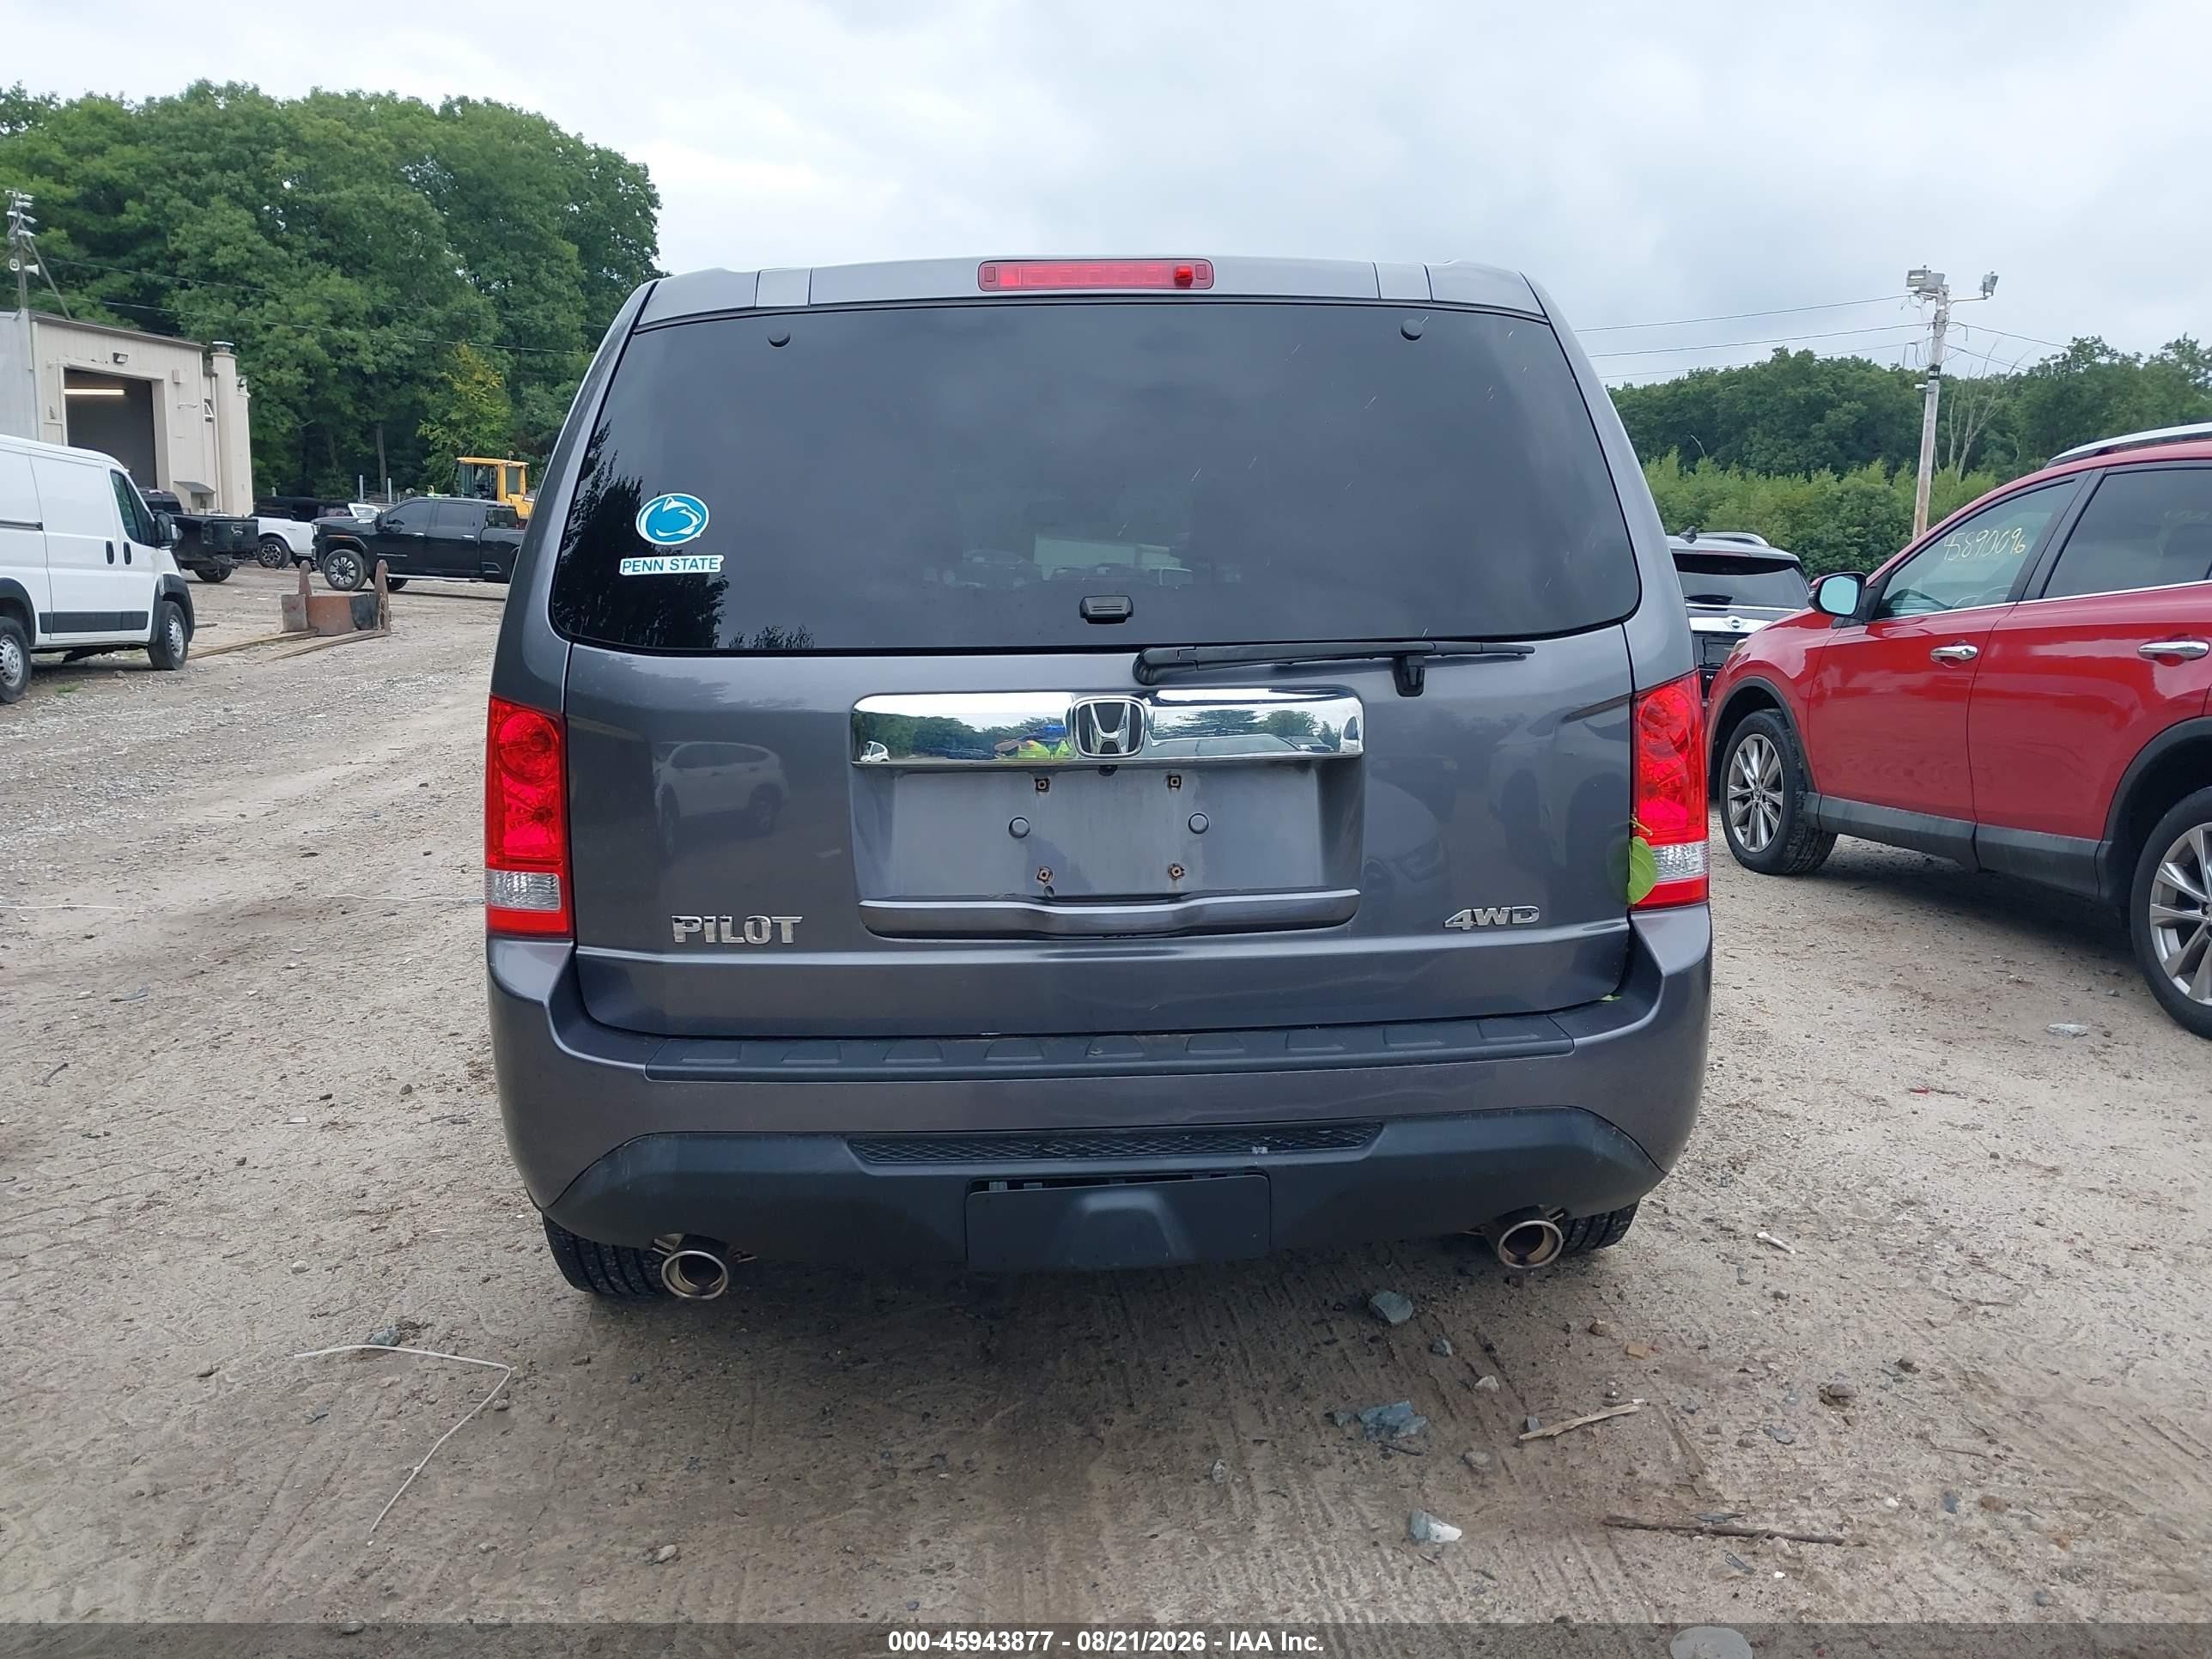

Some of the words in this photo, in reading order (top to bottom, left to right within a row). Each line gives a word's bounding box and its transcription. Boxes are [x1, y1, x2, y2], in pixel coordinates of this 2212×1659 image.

[623, 559, 665, 573] PENN
[669, 557, 719, 571] STATE
[672, 915, 803, 944] PILOT
[1444, 906, 1540, 930] 4WD
